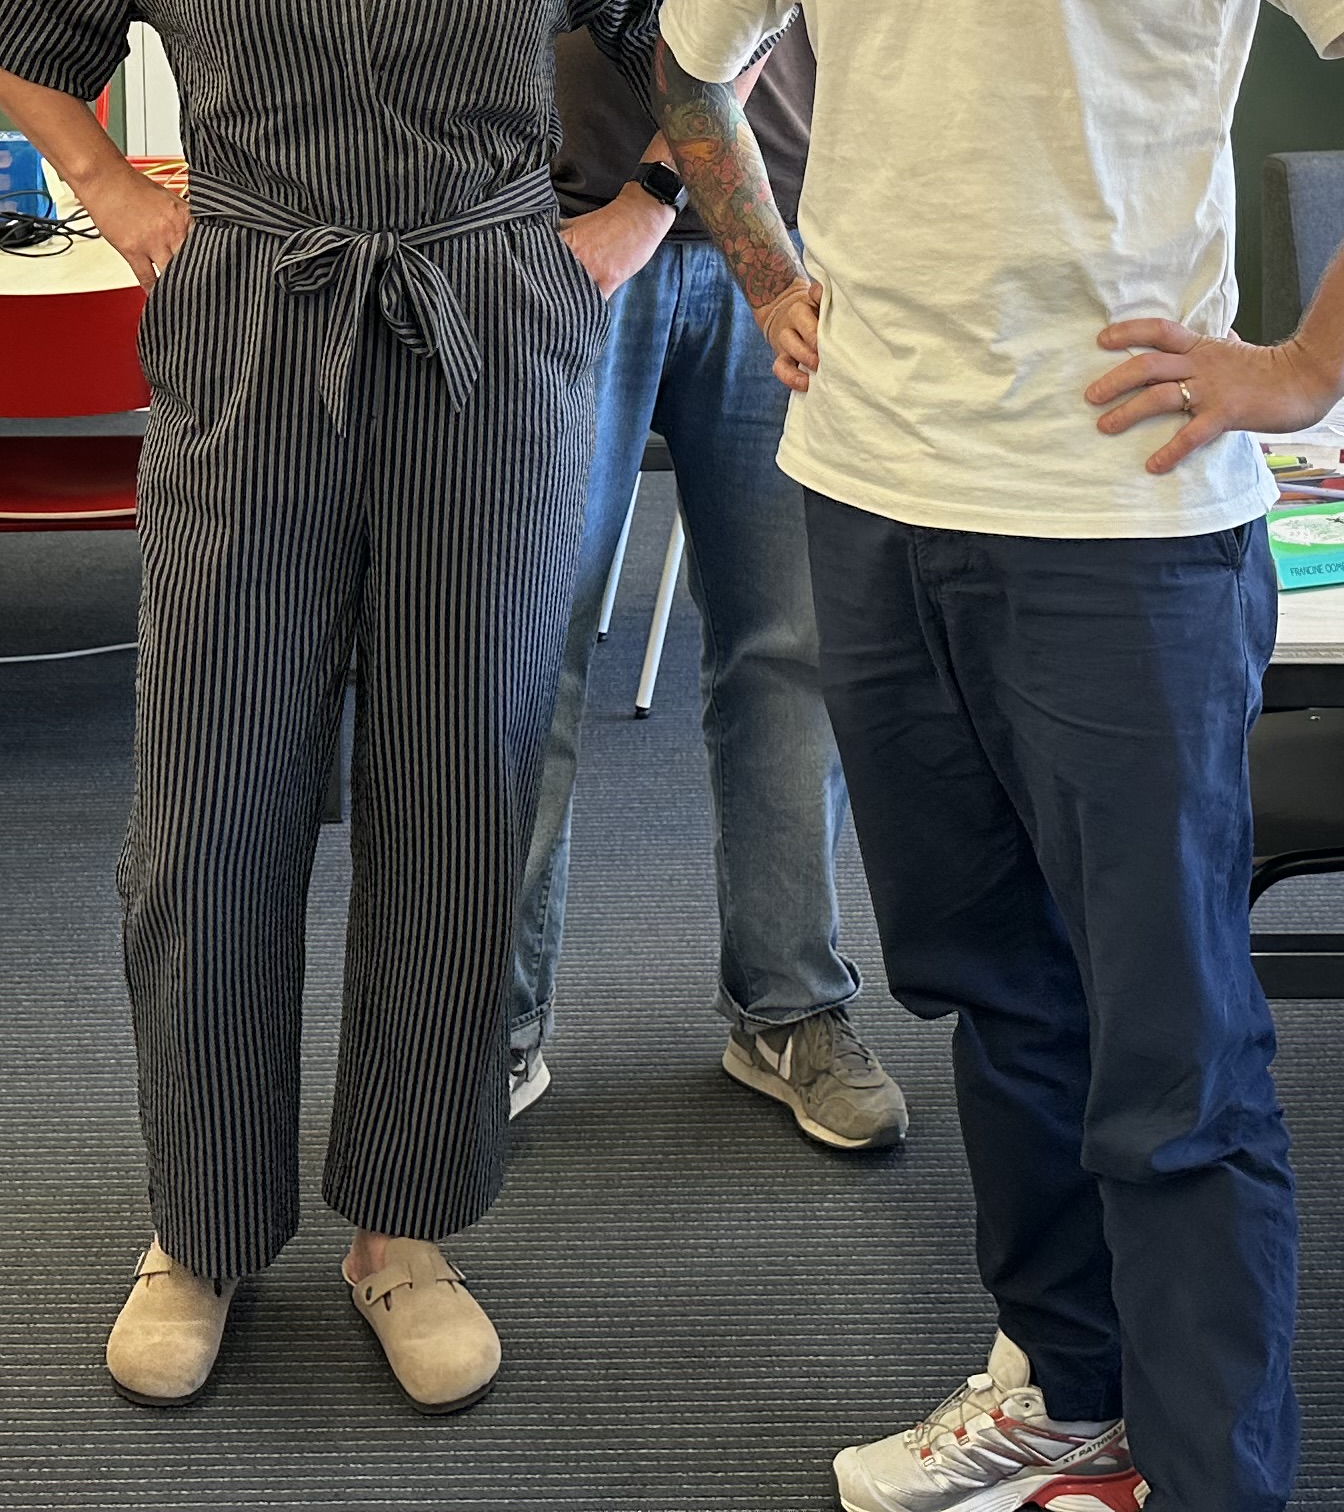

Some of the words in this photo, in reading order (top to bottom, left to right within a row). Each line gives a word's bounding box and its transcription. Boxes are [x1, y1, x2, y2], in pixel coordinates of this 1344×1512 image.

[1290, 564, 1324, 576] FRANCINE
[1063, 1455, 1076, 1465] XT
[1078, 1423, 1123, 1457] PATHWAY
